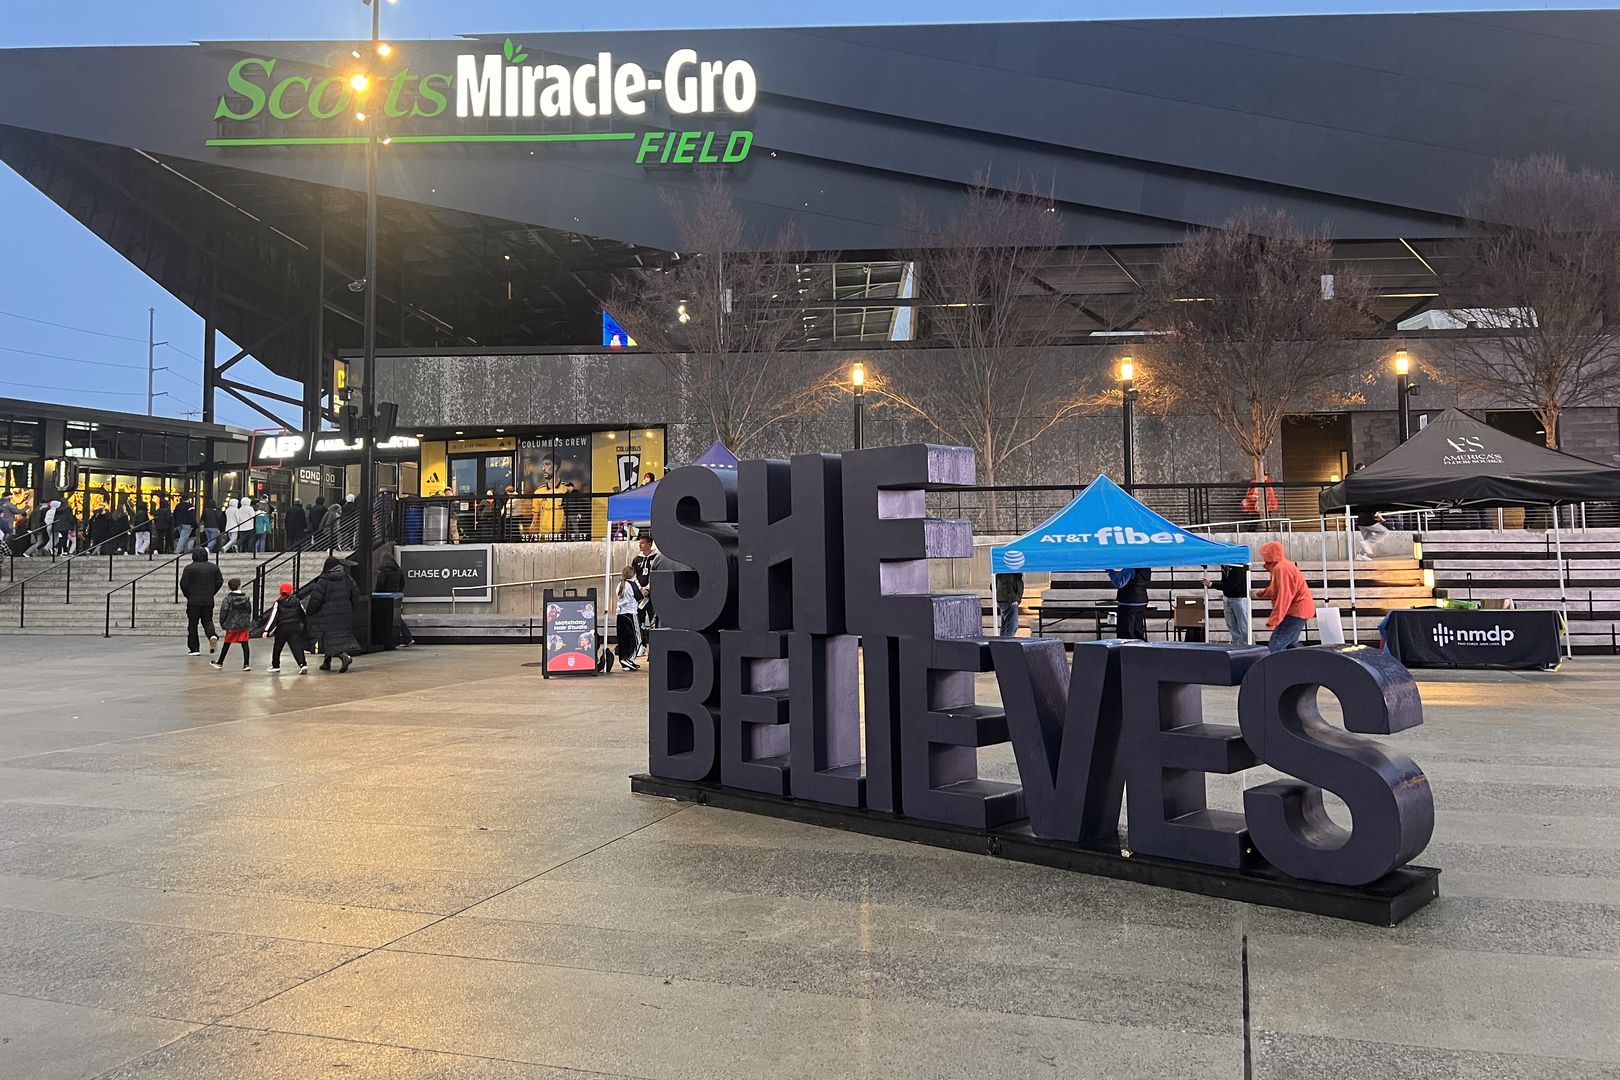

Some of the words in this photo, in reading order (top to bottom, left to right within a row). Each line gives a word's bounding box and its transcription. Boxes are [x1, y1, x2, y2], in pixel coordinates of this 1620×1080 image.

[214, 57, 454, 120] Scots
[456, 46, 758, 118] Miracle-Gro
[635, 130, 755, 165] FIELD
[259, 435, 304, 459] AEP
[521, 439, 563, 448] COLUMBUS
[565, 437, 587, 446] CREW
[650, 443, 977, 640] SHE
[1040, 533, 1092, 543] AT&T
[1094, 525, 1186, 545] fiber
[407, 569, 440, 578] CHASE
[452, 568, 479, 578] PLAZA
[1456, 624, 1515, 647] nmdp
[648, 629, 1434, 887] BELIEVES
